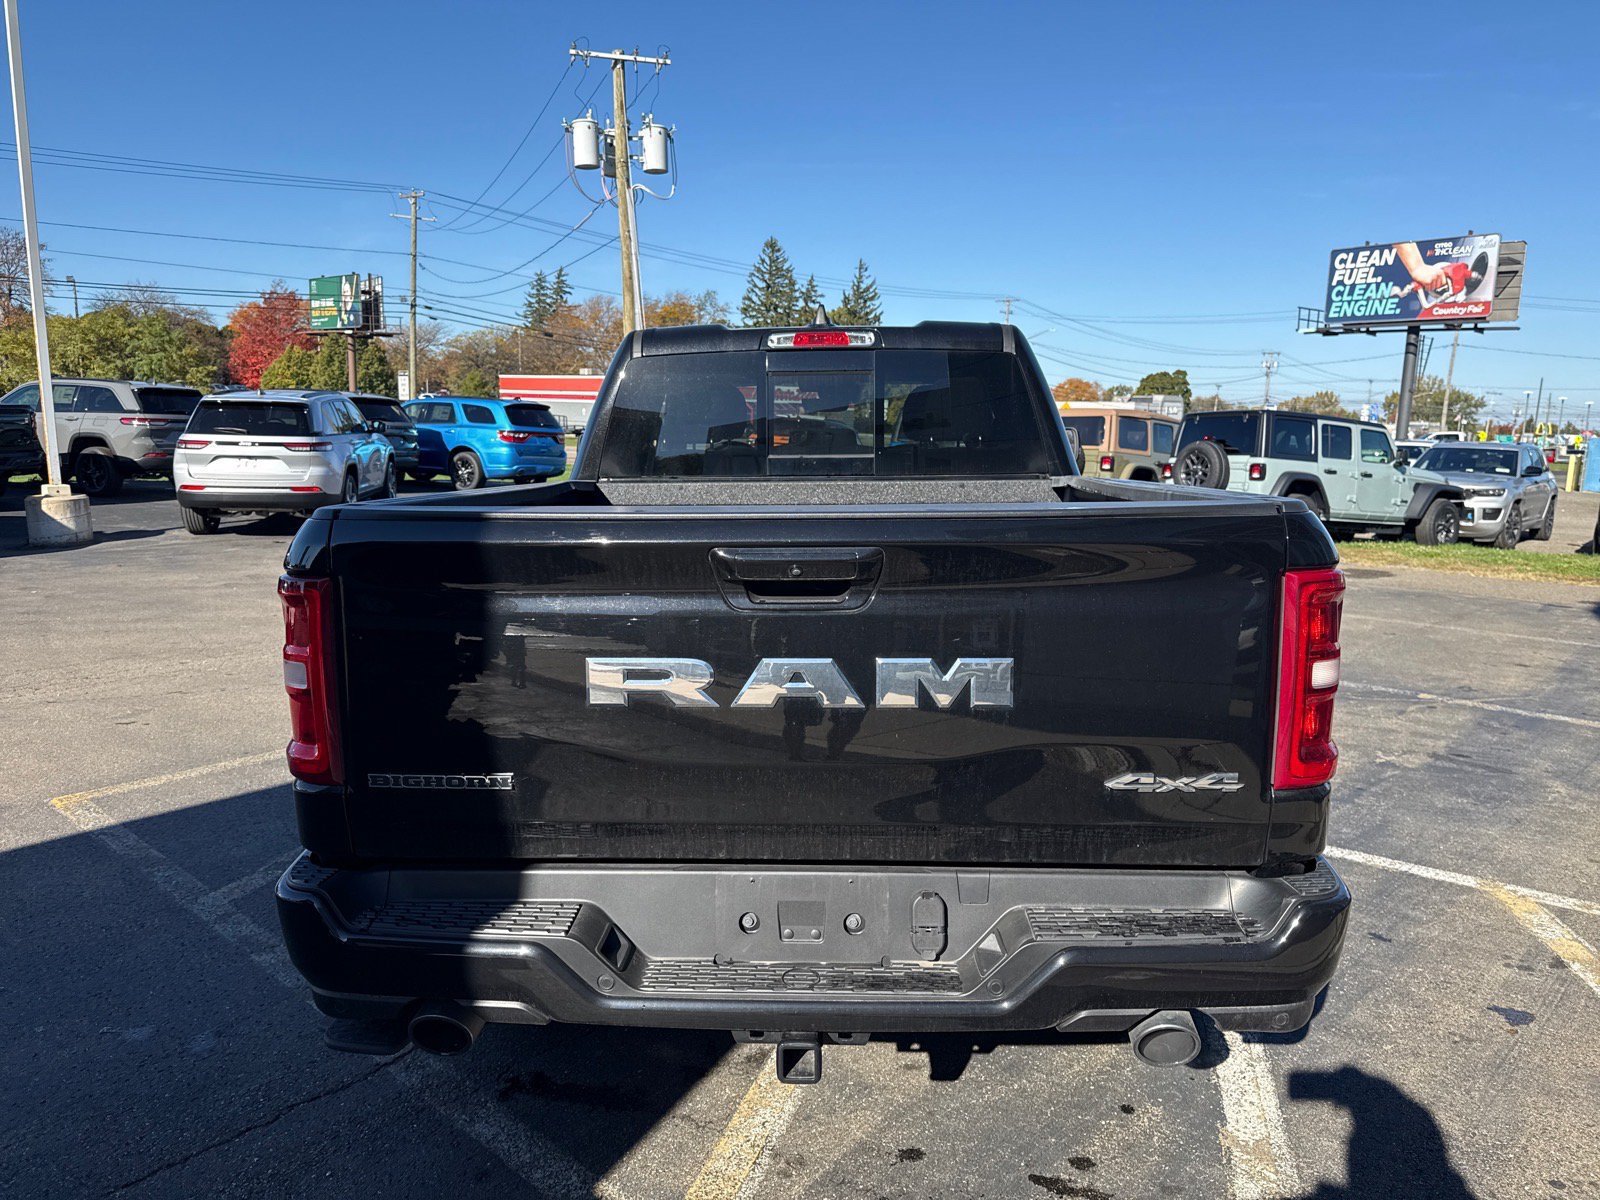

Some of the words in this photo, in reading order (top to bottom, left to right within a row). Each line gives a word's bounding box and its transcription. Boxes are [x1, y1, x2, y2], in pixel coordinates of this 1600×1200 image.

[1334, 248, 1397, 269] CLEAN
[1332, 267, 1382, 286] FUEL.
[1331, 281, 1394, 301] CLEAN
[1328, 298, 1401, 318] ENGINE.
[1432, 306, 1466, 316] Country
[1467, 303, 1485, 313] Fair
[585, 657, 1015, 708] RAM
[367, 772, 514, 790] BIGHORN
